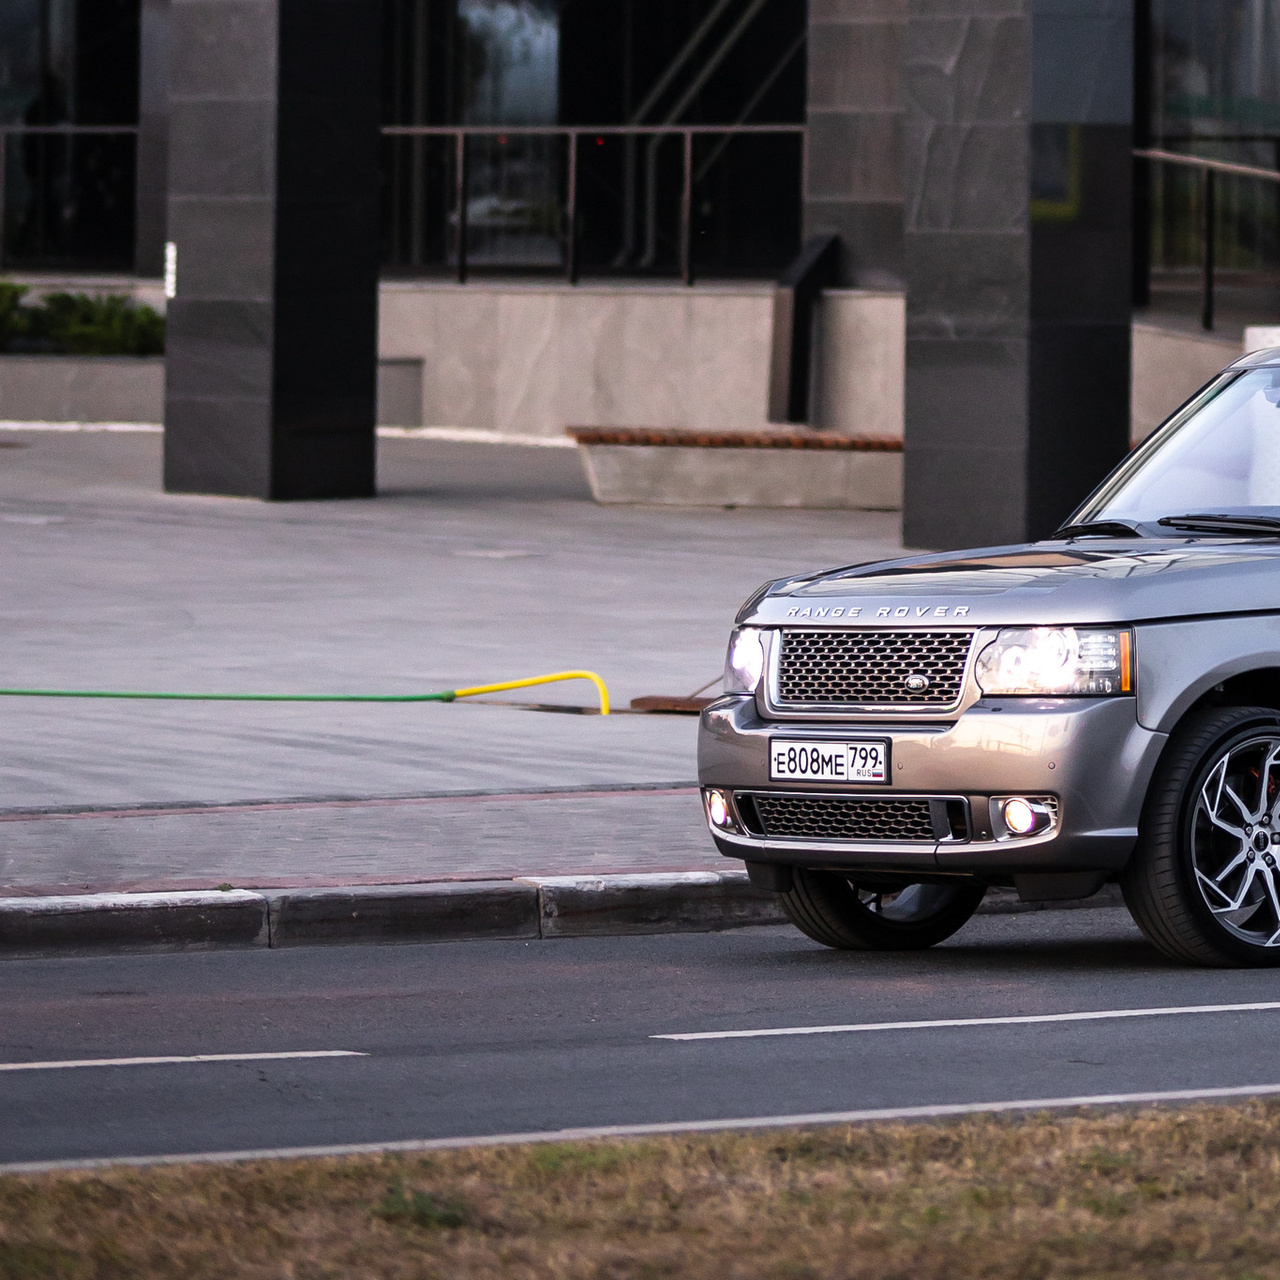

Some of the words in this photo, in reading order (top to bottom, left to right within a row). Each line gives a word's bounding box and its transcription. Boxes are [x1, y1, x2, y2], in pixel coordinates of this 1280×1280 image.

[787, 606, 863, 618] RANGE
[875, 605, 972, 618] ROVER
[776, 746, 845, 776] E808ME
[848, 746, 879, 769] 799
[856, 768, 872, 777] RUS
